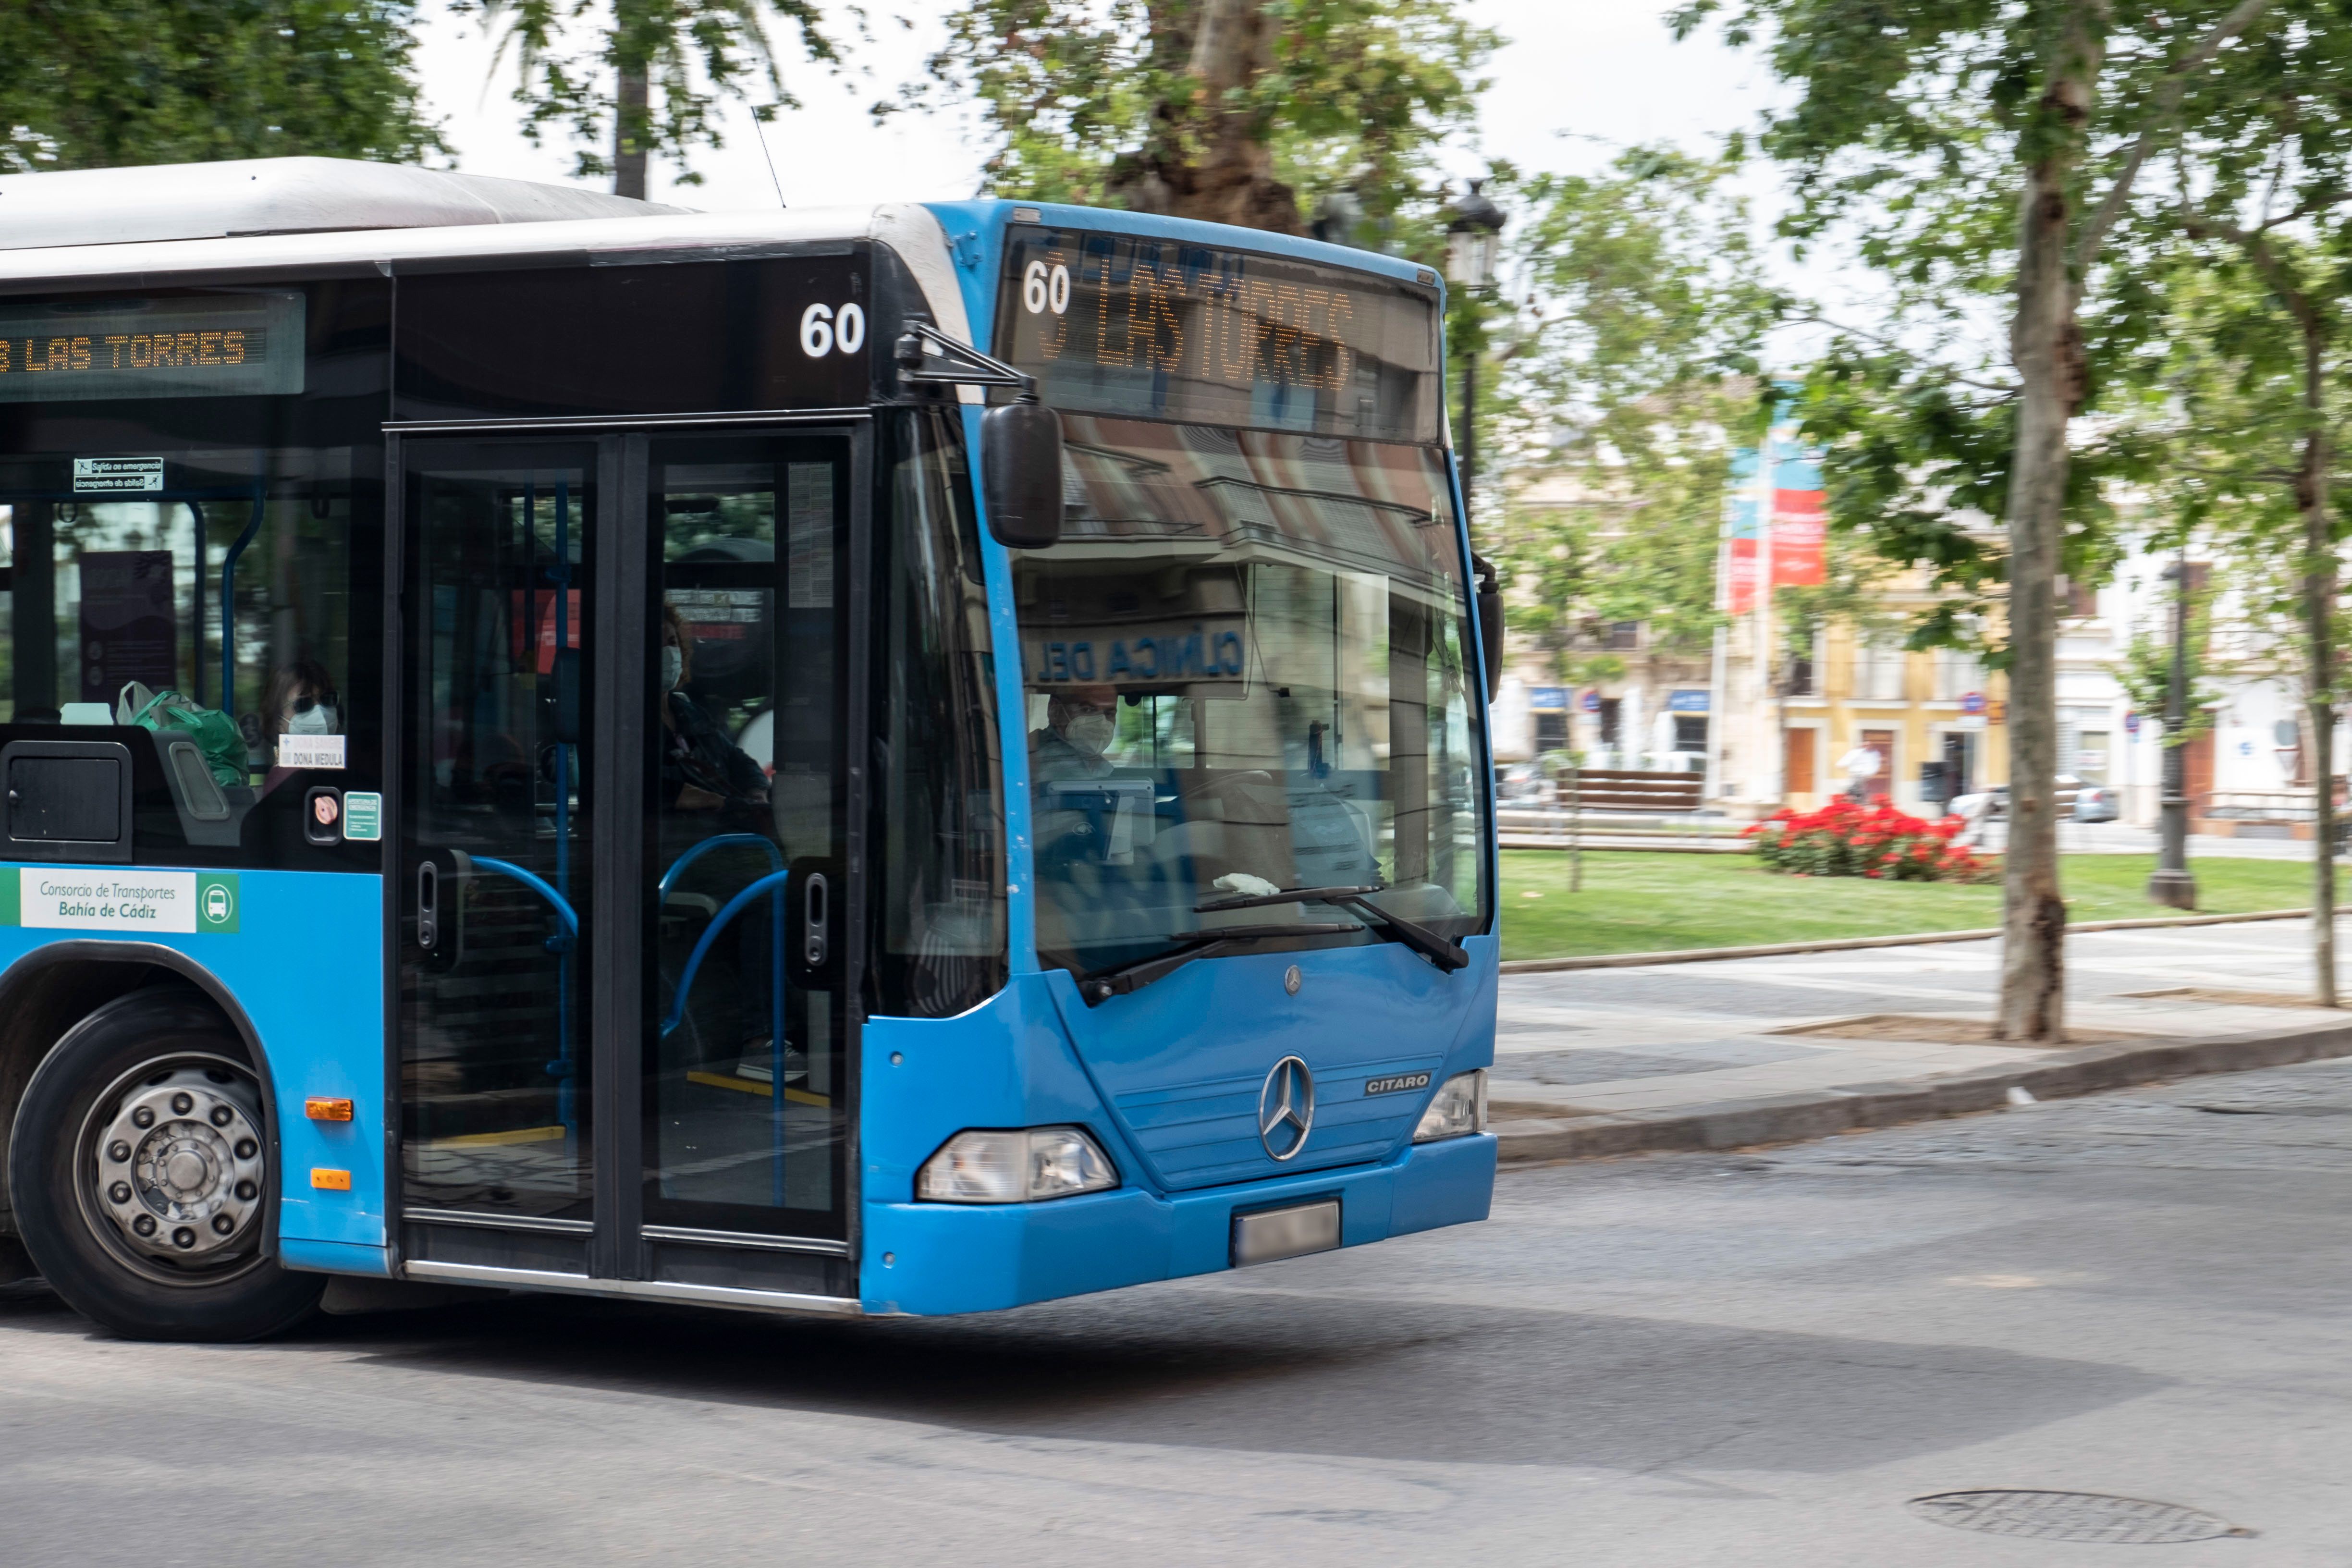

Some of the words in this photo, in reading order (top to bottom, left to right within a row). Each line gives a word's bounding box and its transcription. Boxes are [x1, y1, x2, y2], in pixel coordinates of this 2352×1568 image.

[1023, 260, 1070, 314] 60
[800, 303, 865, 357] 60
[1097, 258, 1186, 372] LAS
[1199, 273, 1353, 391] TORRES
[26, 337, 91, 371] LAS
[105, 331, 245, 368] TORRES
[122, 461, 161, 471] emergencia
[294, 752, 312, 765] DONA
[40, 881, 92, 896] Consorcio
[96, 883, 109, 897] de
[112, 883, 175, 903] Transportes
[59, 902, 95, 917] Bahía
[100, 903, 115, 917] de
[120, 904, 157, 919] Cádiz
[1367, 1075, 1428, 1093] CITARO
